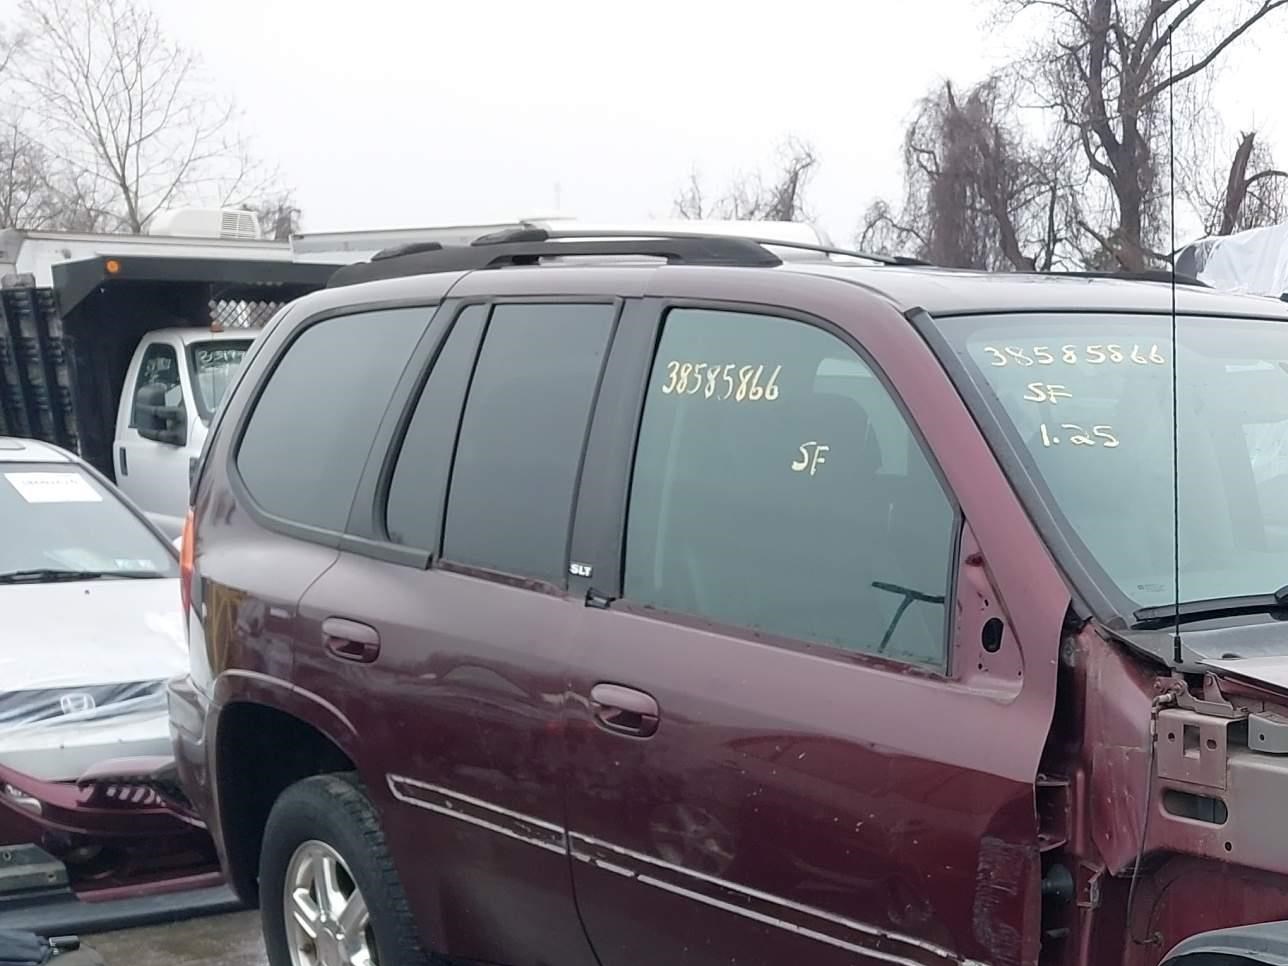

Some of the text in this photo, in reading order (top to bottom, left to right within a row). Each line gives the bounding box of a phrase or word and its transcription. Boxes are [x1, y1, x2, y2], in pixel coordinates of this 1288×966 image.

[984, 345, 1166, 367] 38585866
[662, 360, 782, 401] 38585866
[1024, 382, 1073, 404] SF
[1040, 423, 1120, 448] 1.25
[792, 441, 830, 476] SF
[570, 563, 592, 577] SLT
